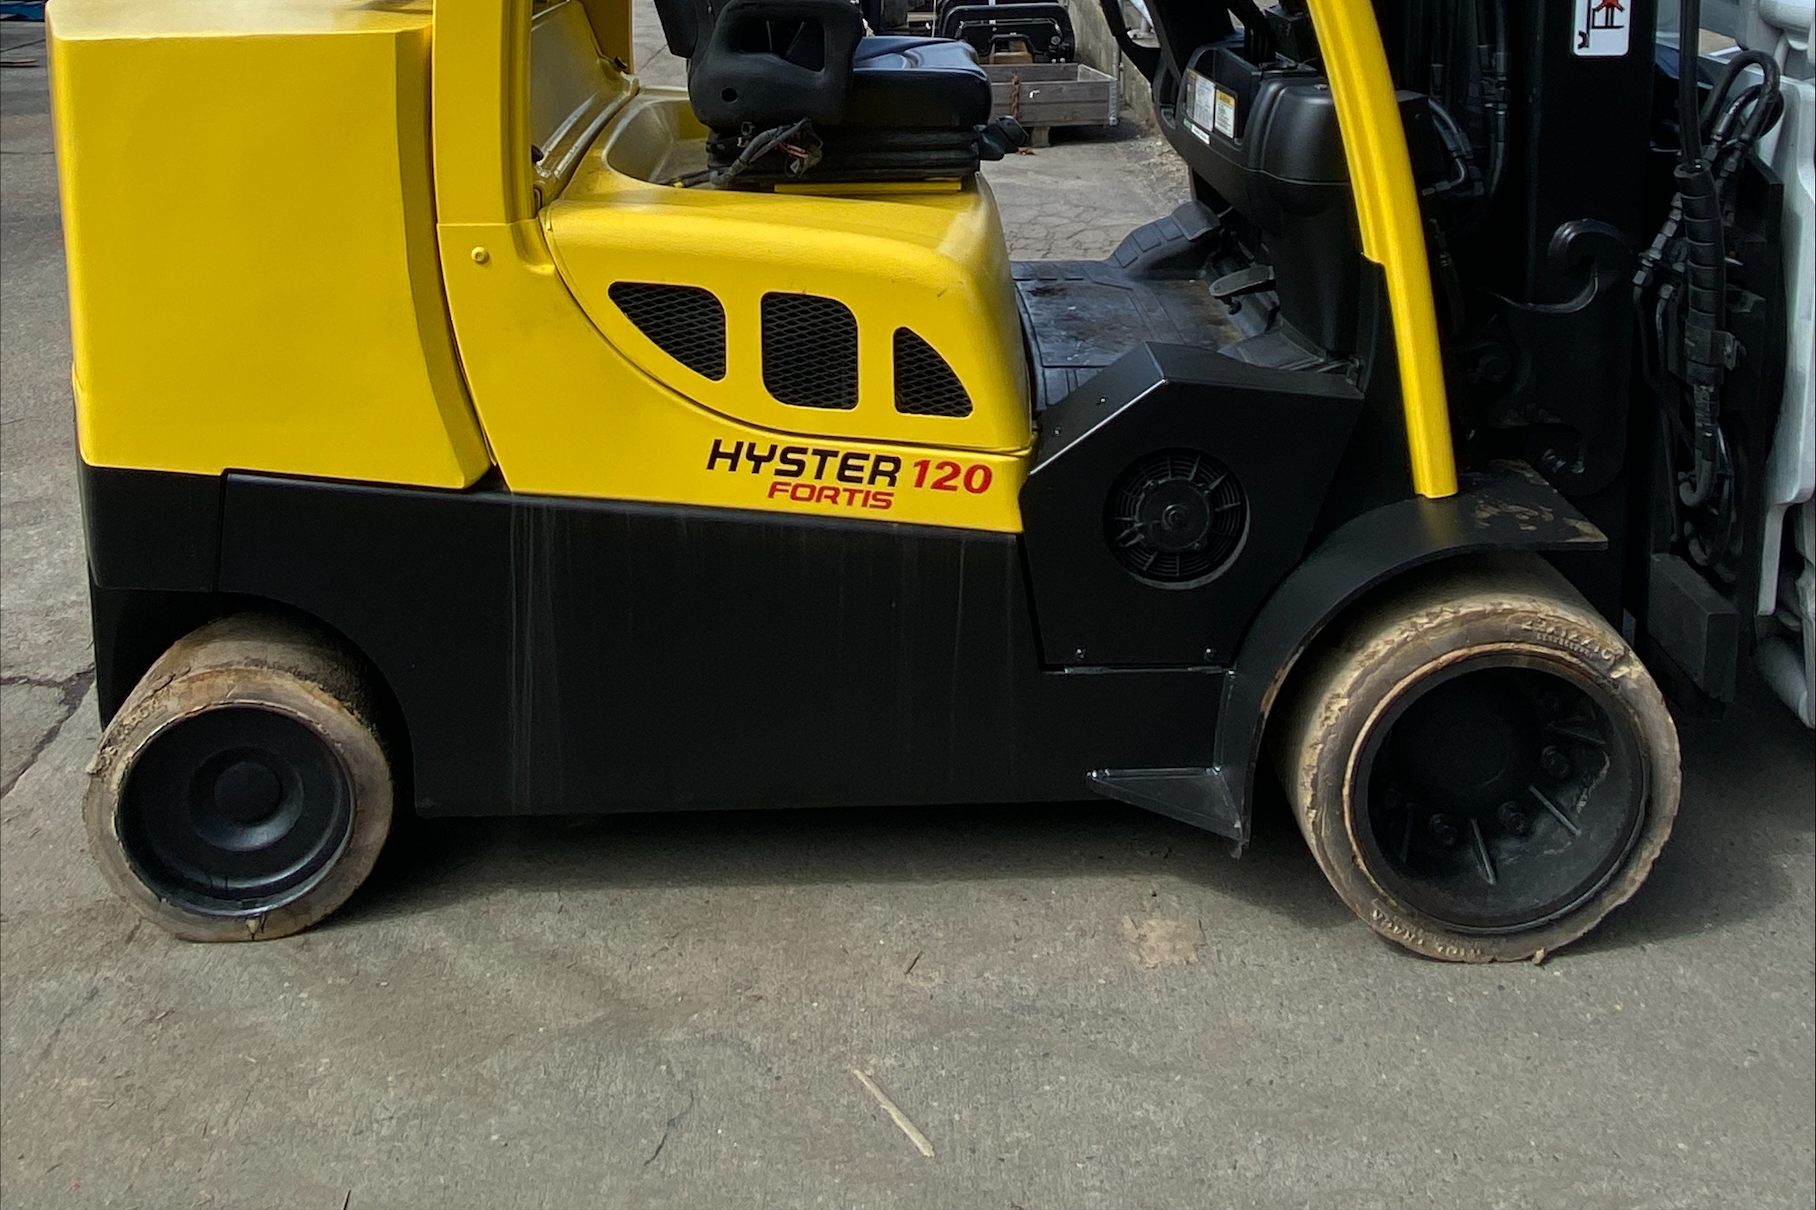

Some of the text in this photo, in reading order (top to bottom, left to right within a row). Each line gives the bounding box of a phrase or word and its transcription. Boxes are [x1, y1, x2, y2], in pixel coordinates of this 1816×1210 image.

[706, 439, 993, 494] HYSTER 120
[767, 480, 895, 510] FORTIS
